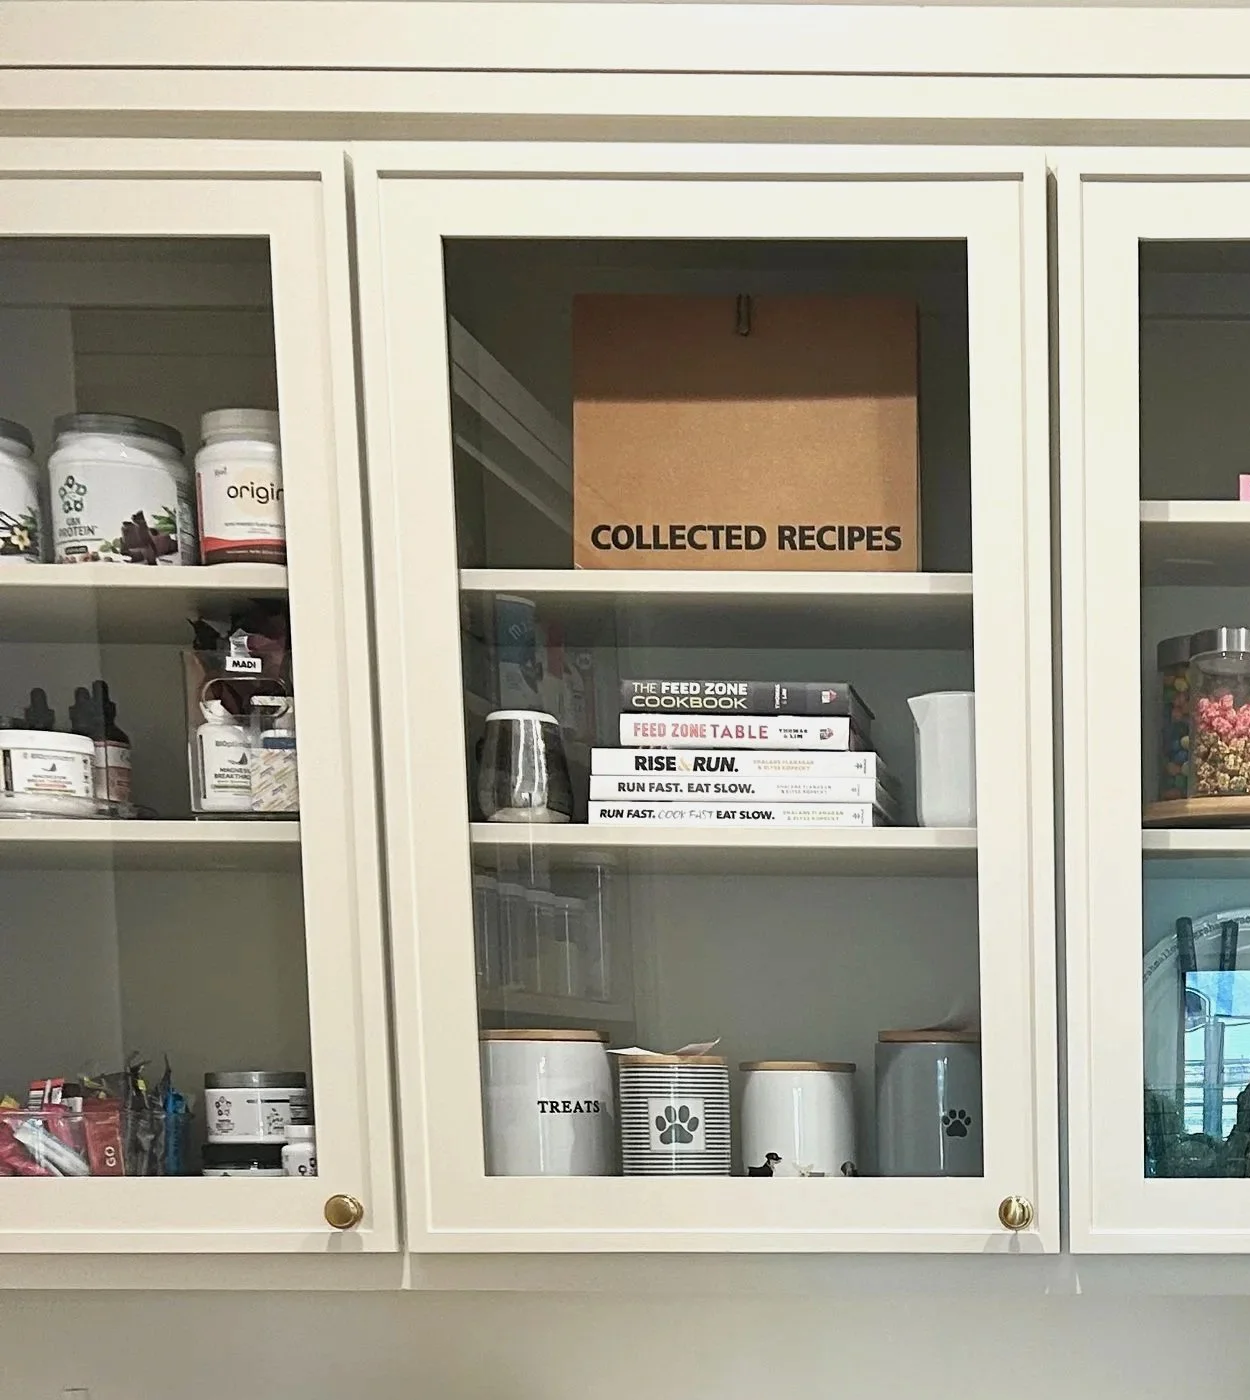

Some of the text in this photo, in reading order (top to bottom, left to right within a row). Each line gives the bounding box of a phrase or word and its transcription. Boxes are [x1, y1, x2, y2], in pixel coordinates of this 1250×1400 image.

[591, 524, 903, 551] COLLECTED RECIPES
[231, 660, 256, 669] MADI
[632, 682, 748, 696] THE FEED ZONE
[632, 696, 748, 710] COOKBOOK
[633, 722, 768, 740] FEED ZONE TABLE
[634, 756, 677, 771] RISE
[692, 756, 739, 773] RUN.
[617, 782, 756, 794] RUN FAST. EAT SLOW.
[599, 809, 624, 819] RUN
[626, 809, 656, 819] FAST.
[716, 810, 737, 819] EAT
[739, 811, 776, 820] SLOW.
[537, 1100, 600, 1113] TREATS
